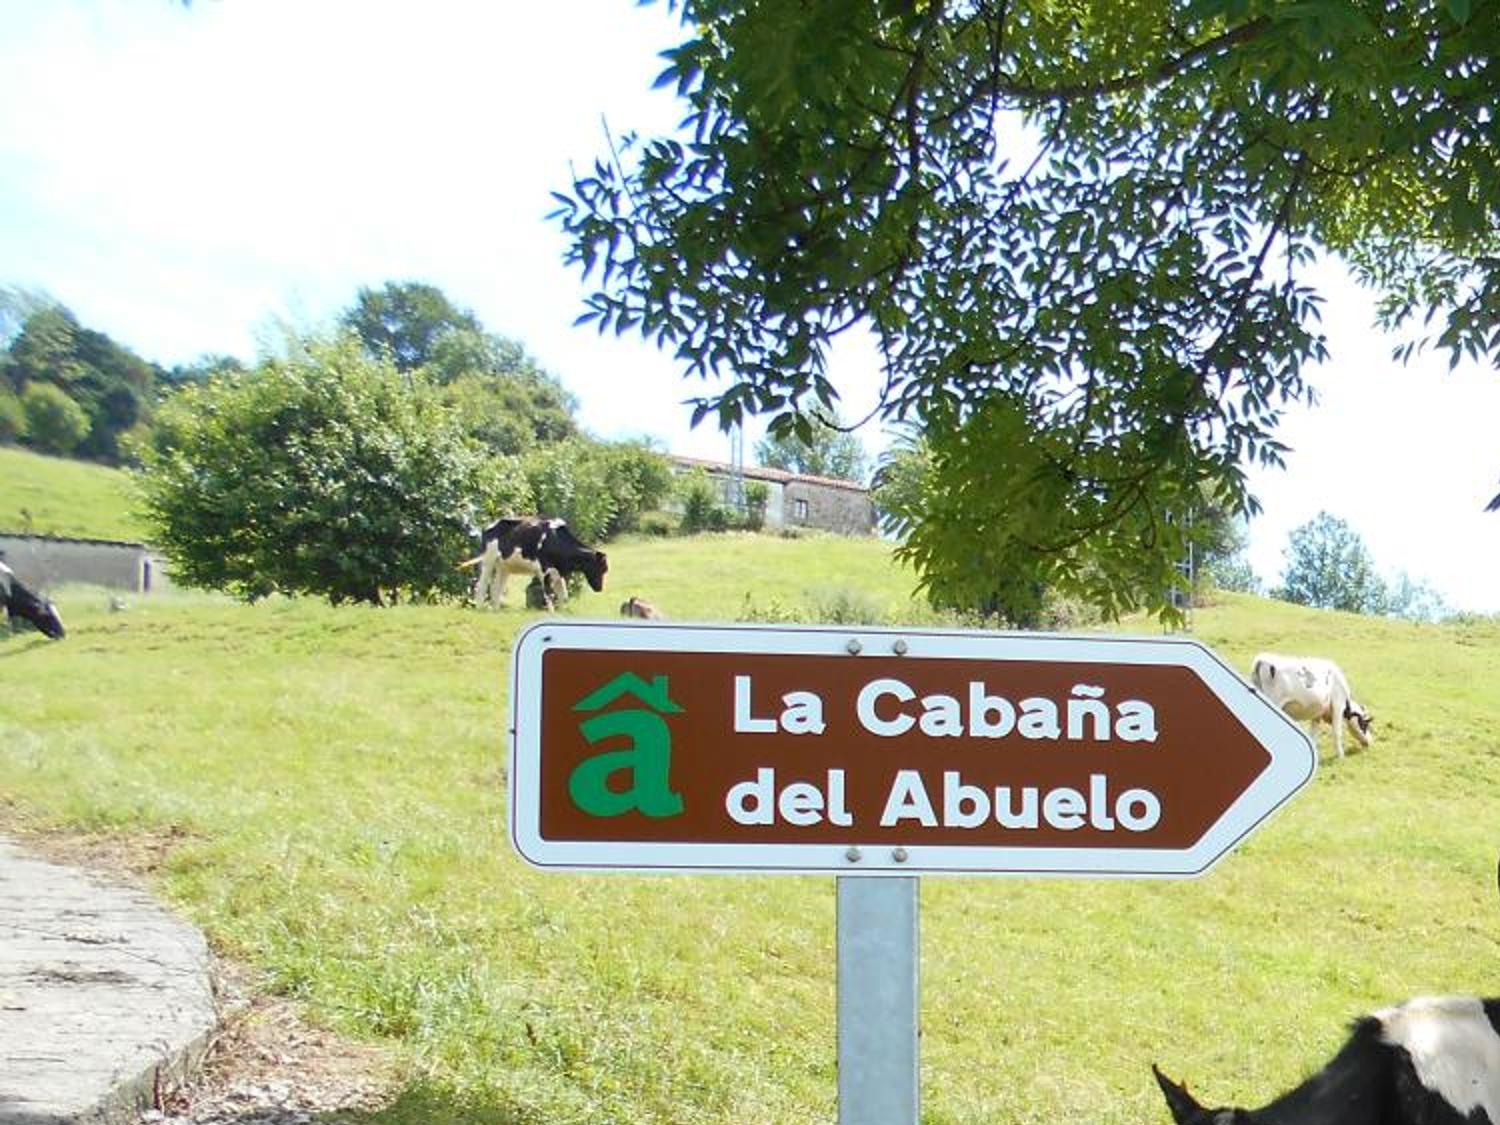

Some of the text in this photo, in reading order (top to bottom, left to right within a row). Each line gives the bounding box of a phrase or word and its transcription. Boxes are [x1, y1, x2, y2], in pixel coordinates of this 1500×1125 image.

[733, 674, 1159, 742] La Cabaña
[725, 766, 1161, 832] del Abuelo
